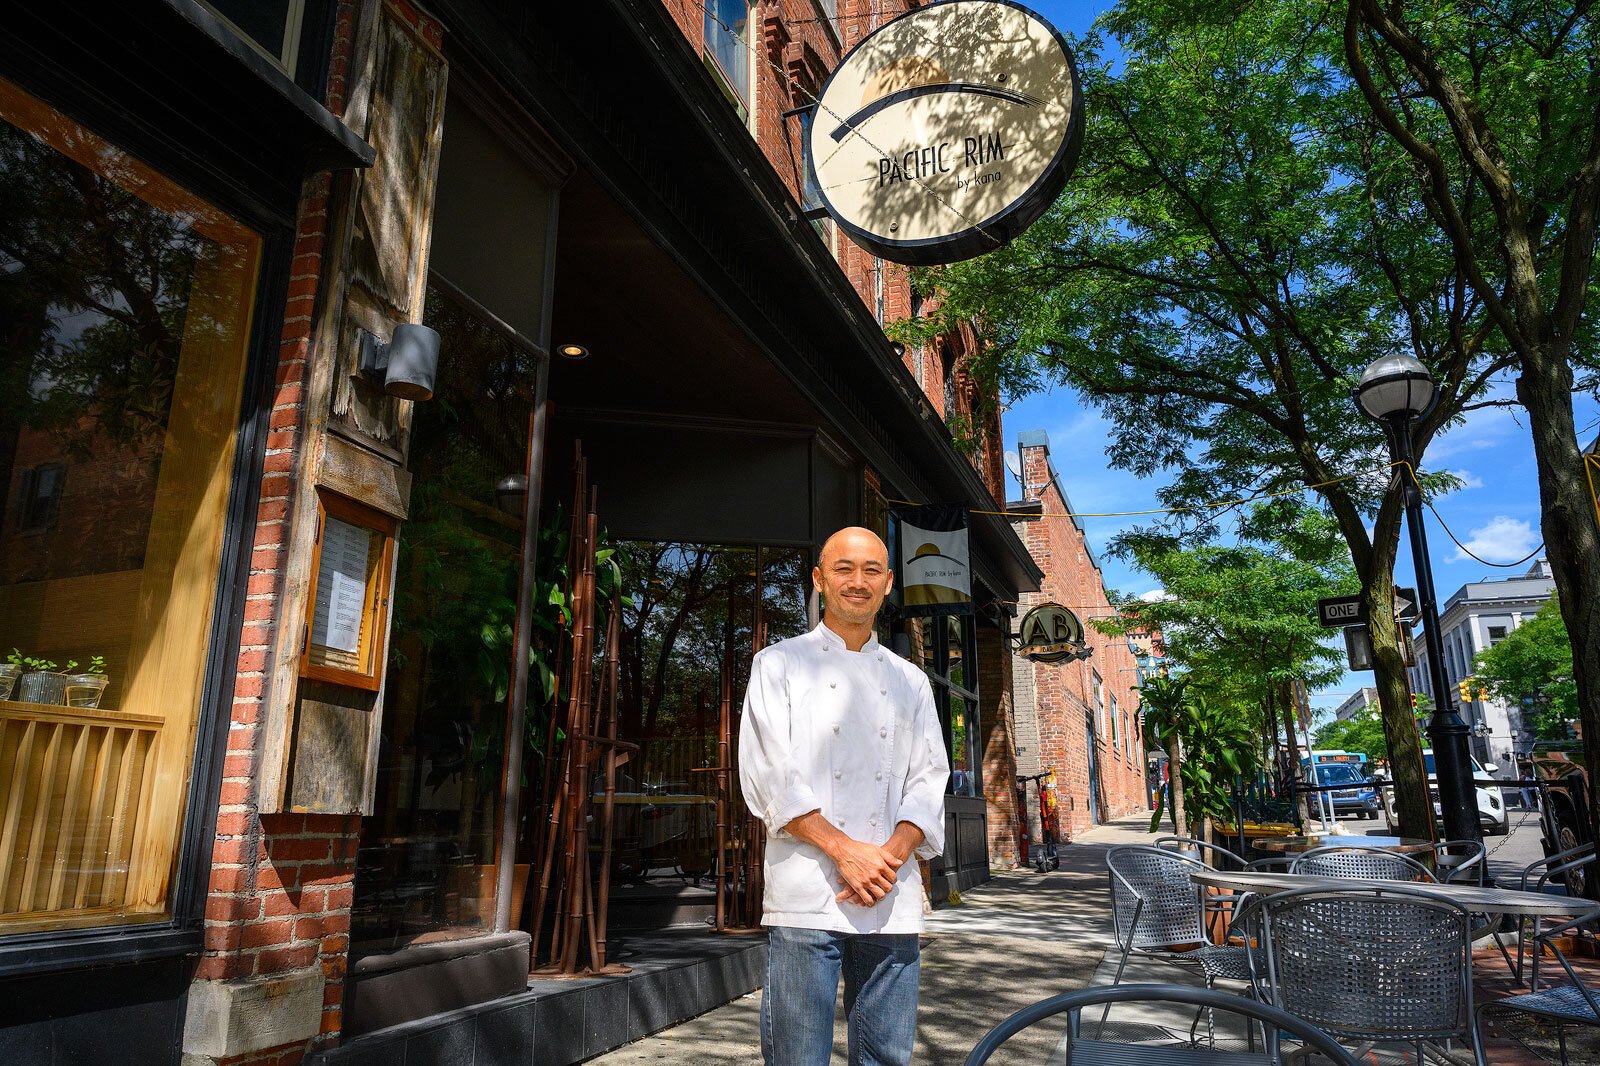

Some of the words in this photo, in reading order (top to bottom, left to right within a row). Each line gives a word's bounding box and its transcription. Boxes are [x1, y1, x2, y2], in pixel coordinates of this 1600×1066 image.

[879, 142, 950, 188] PACIFIC
[964, 131, 1004, 168] RIM
[957, 175, 970, 193] by
[974, 171, 1001, 185] kana
[1329, 604, 1355, 617] ONE
